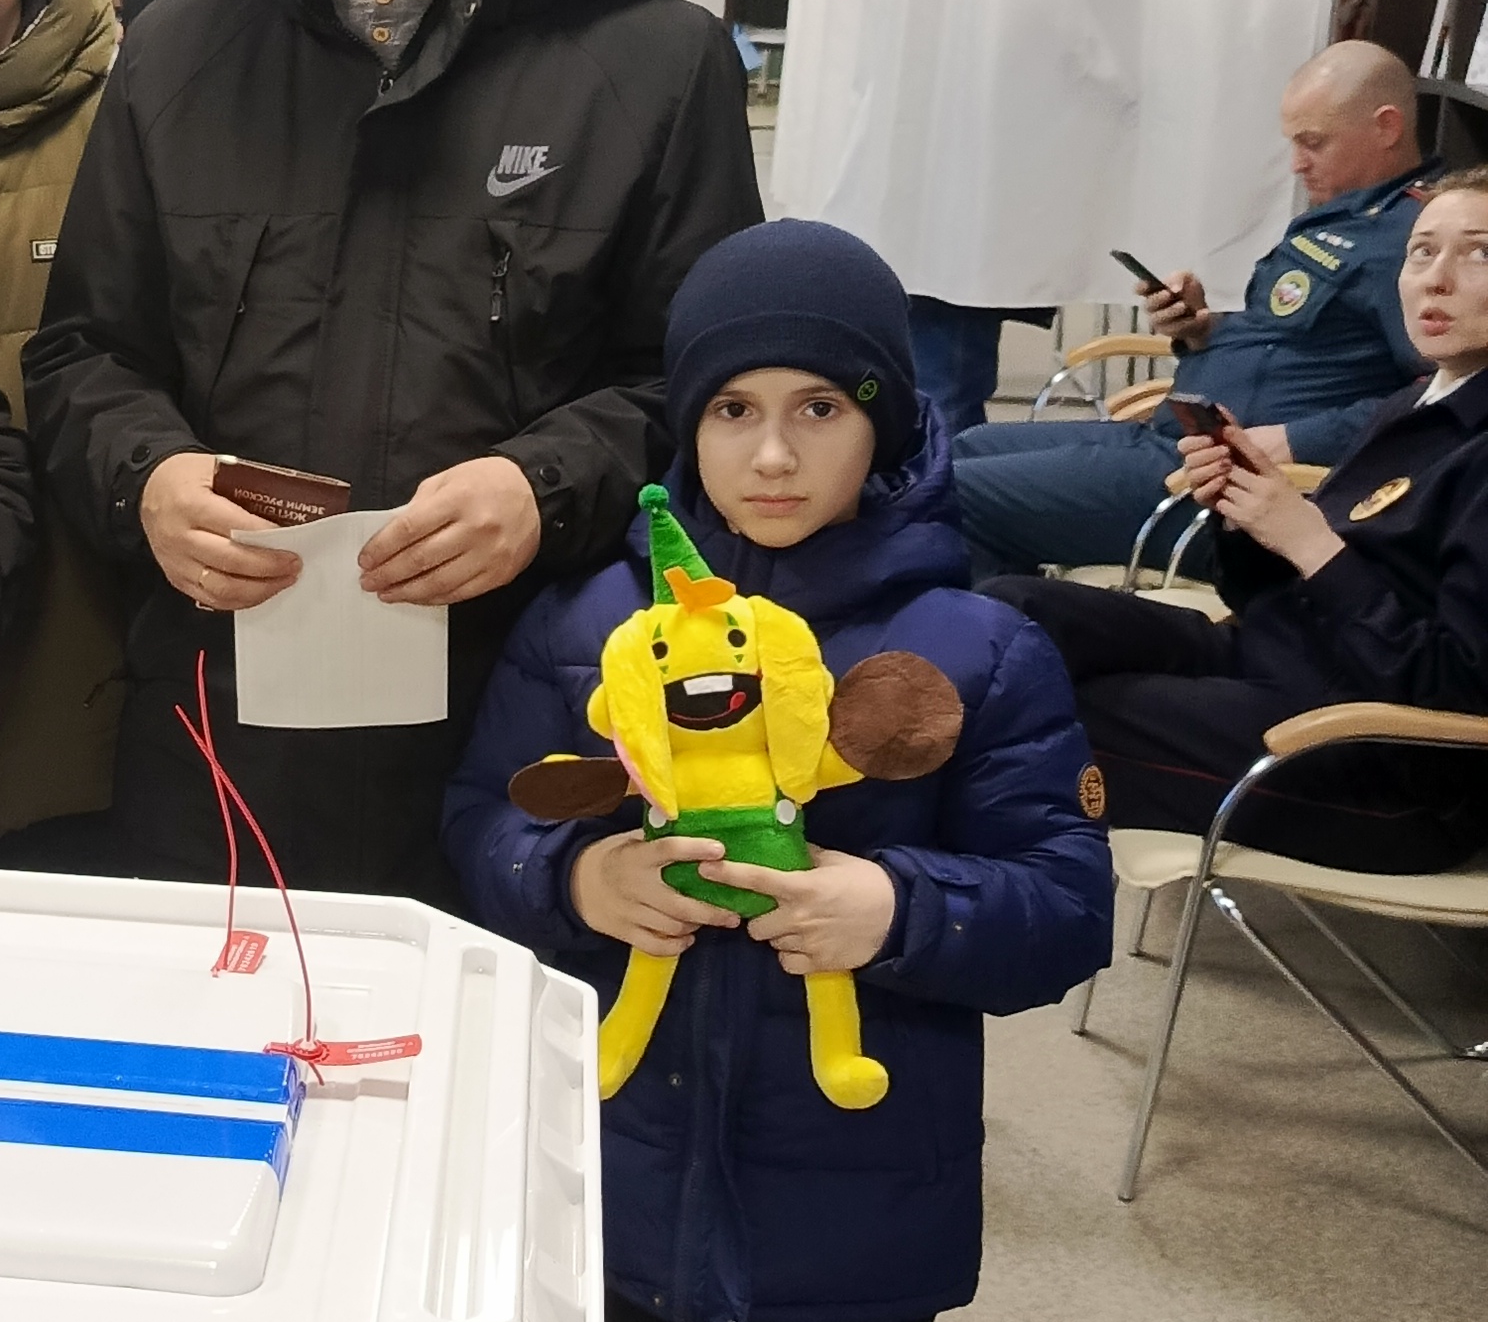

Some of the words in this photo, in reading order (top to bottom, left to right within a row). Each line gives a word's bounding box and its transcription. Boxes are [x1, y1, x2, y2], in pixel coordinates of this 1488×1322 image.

[497, 145, 550, 175] NIKE
[234, 487, 284, 507] РУССКОЙ
[286, 500, 326, 515] ЗЕМЛИ
